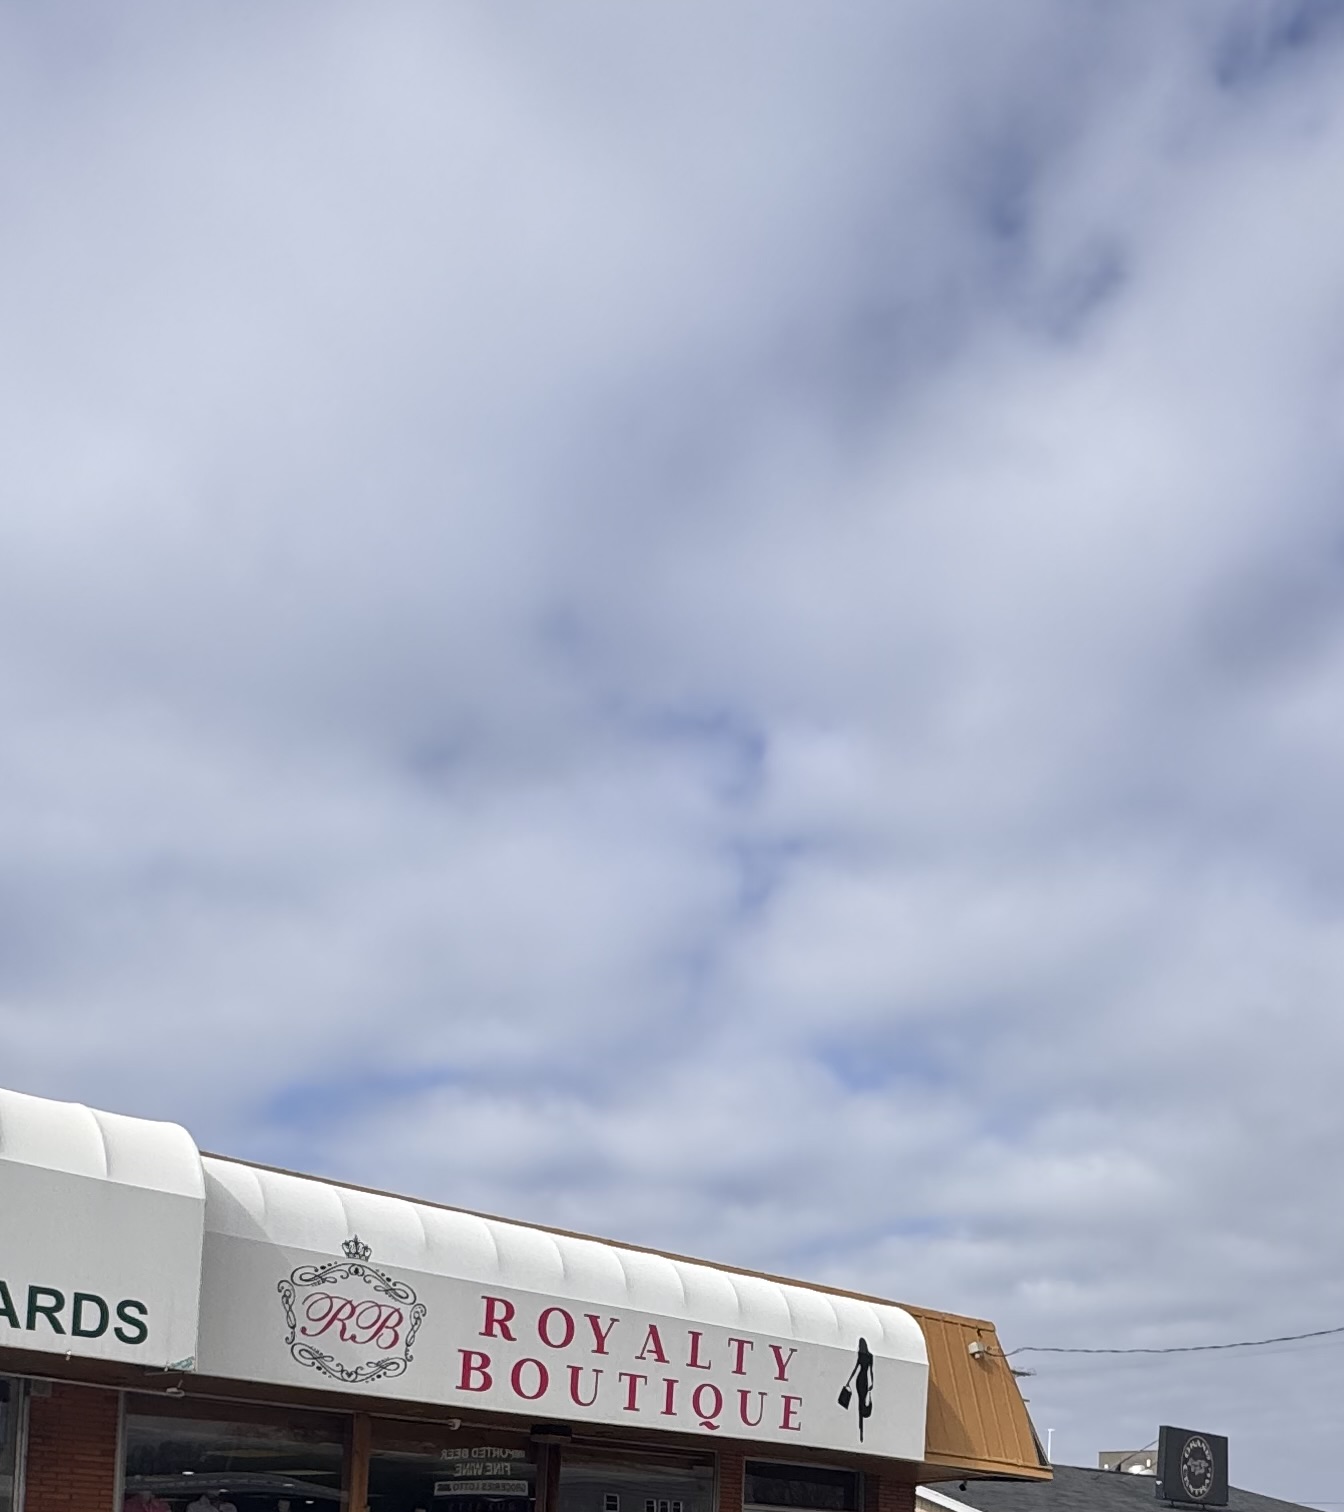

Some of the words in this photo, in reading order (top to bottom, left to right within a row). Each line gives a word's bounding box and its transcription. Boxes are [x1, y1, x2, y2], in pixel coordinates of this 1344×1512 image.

[300, 1292, 404, 1350] RB
[478, 1295, 798, 1382] ROYALTY
[455, 1348, 803, 1431] BOUTIQUE
